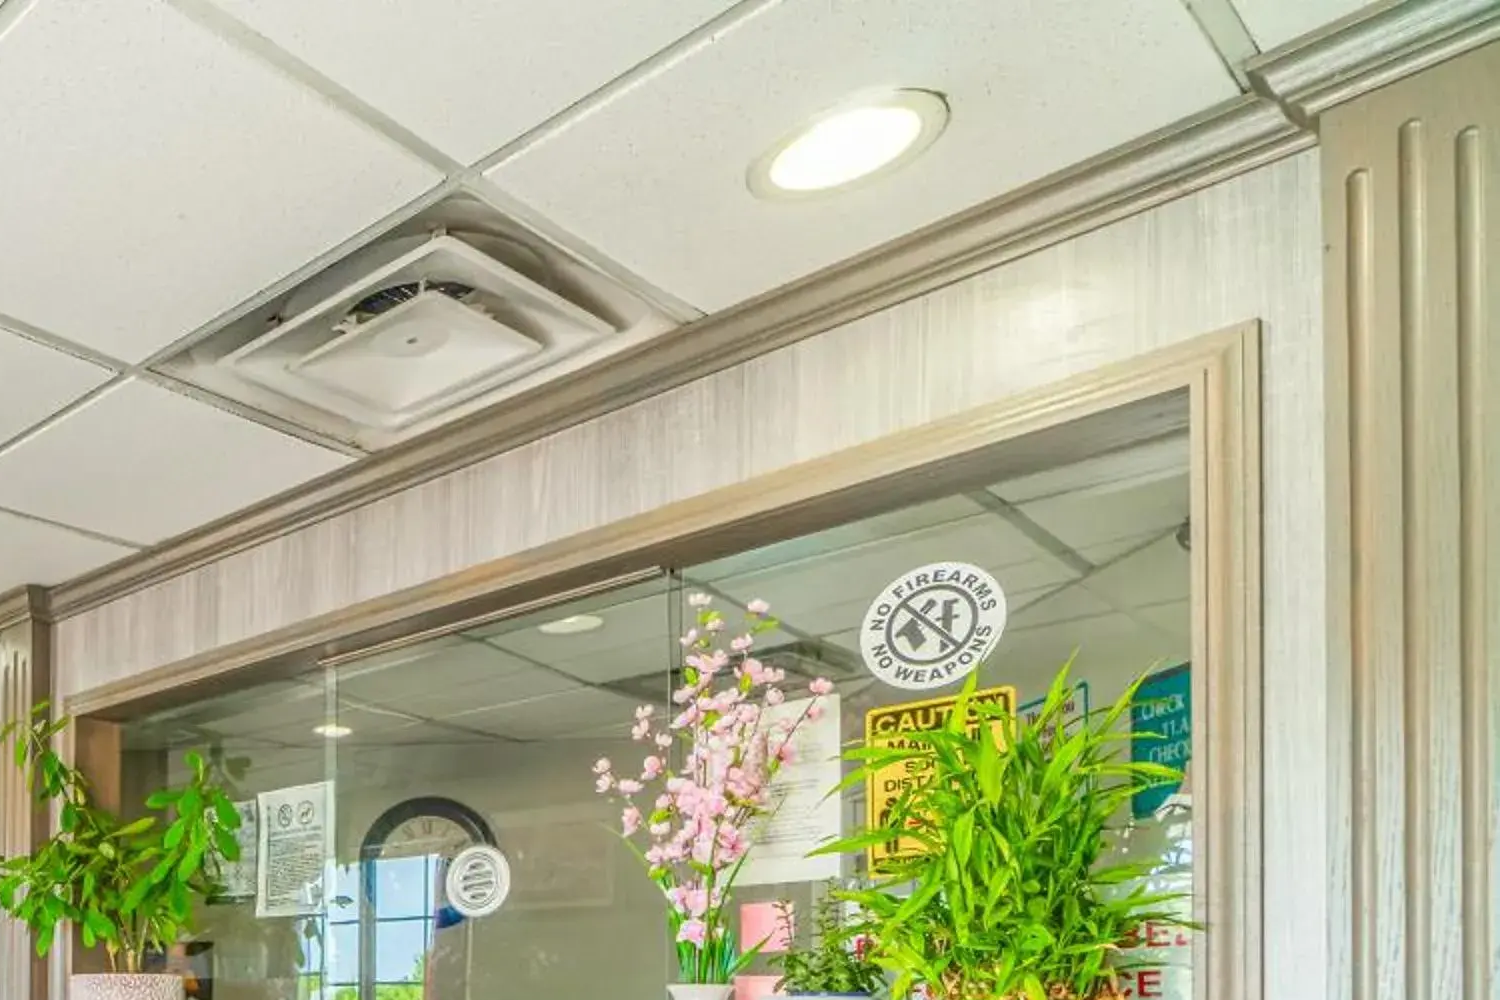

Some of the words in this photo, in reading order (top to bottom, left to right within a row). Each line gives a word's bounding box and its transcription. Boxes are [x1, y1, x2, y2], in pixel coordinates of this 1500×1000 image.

[870, 603, 892, 631] NO
[892, 569, 997, 611] FIREARMS
[871, 643, 893, 669] NO
[894, 624, 992, 683] WEAPONS
